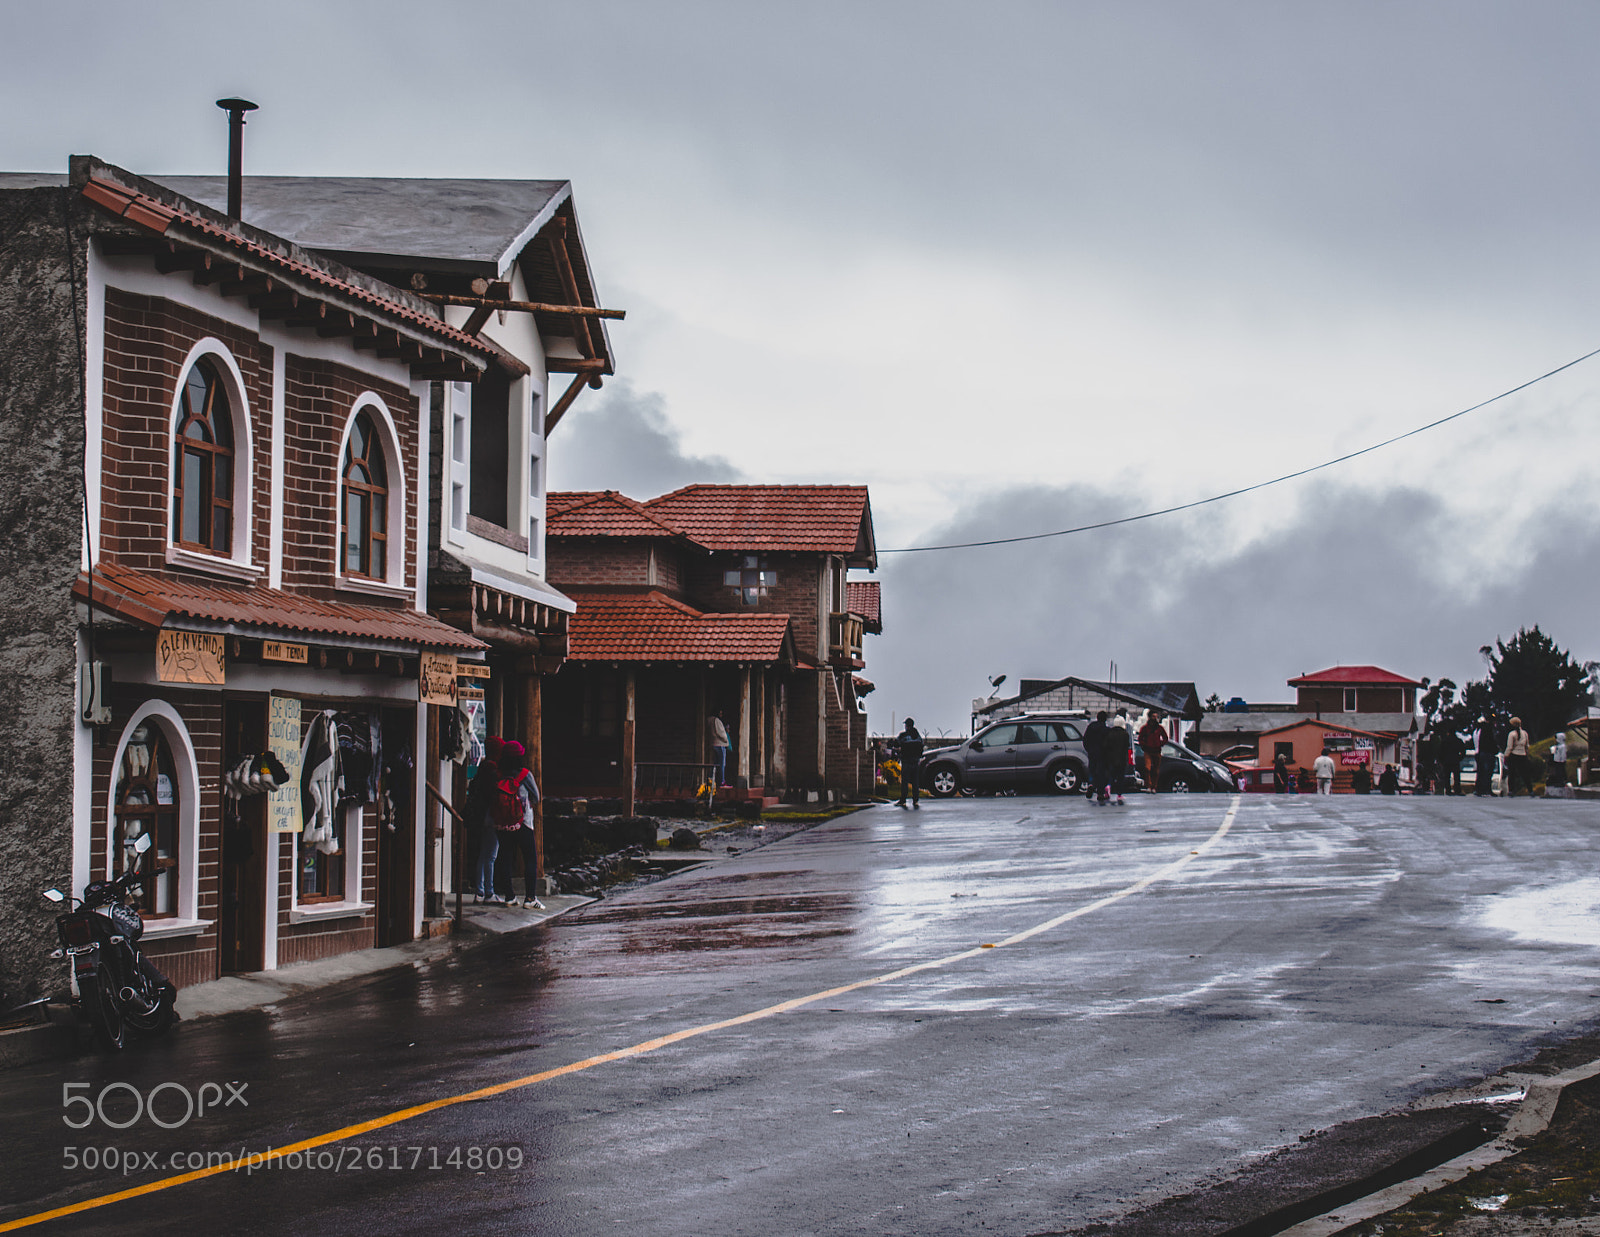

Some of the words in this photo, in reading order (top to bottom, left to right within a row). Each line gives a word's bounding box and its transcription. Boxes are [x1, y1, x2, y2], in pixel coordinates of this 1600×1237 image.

[160, 632, 225, 673] BIENVENIDOS
[266, 643, 282, 658] MINI
[271, 697, 282, 718] SE
